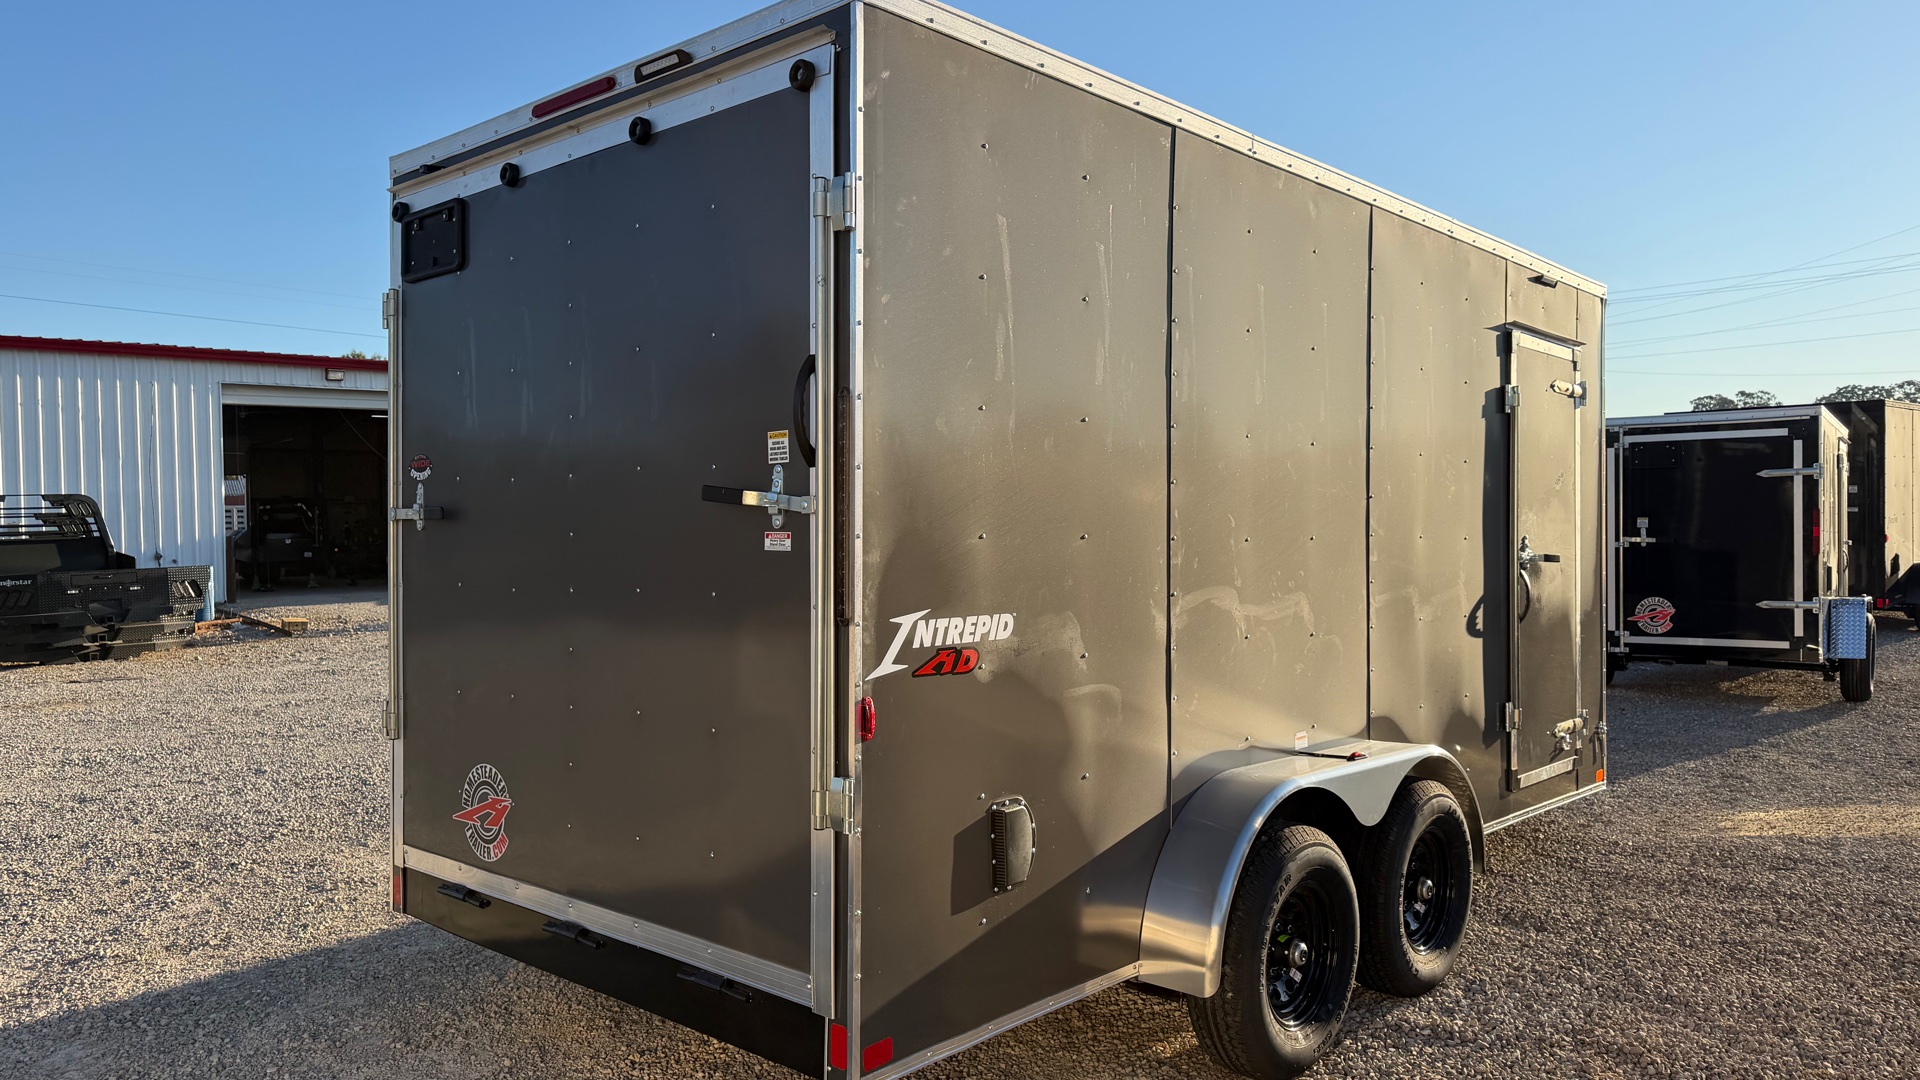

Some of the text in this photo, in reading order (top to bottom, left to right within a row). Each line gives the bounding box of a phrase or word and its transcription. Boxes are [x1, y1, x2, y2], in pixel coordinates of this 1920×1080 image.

[410, 467, 431, 480] OPENING
[411, 460, 430, 468] WIDE
[865, 608, 1014, 681] INTREPID
[462, 764, 508, 808] HOMESTEADER
[464, 824, 509, 861] TRAILER.COM
